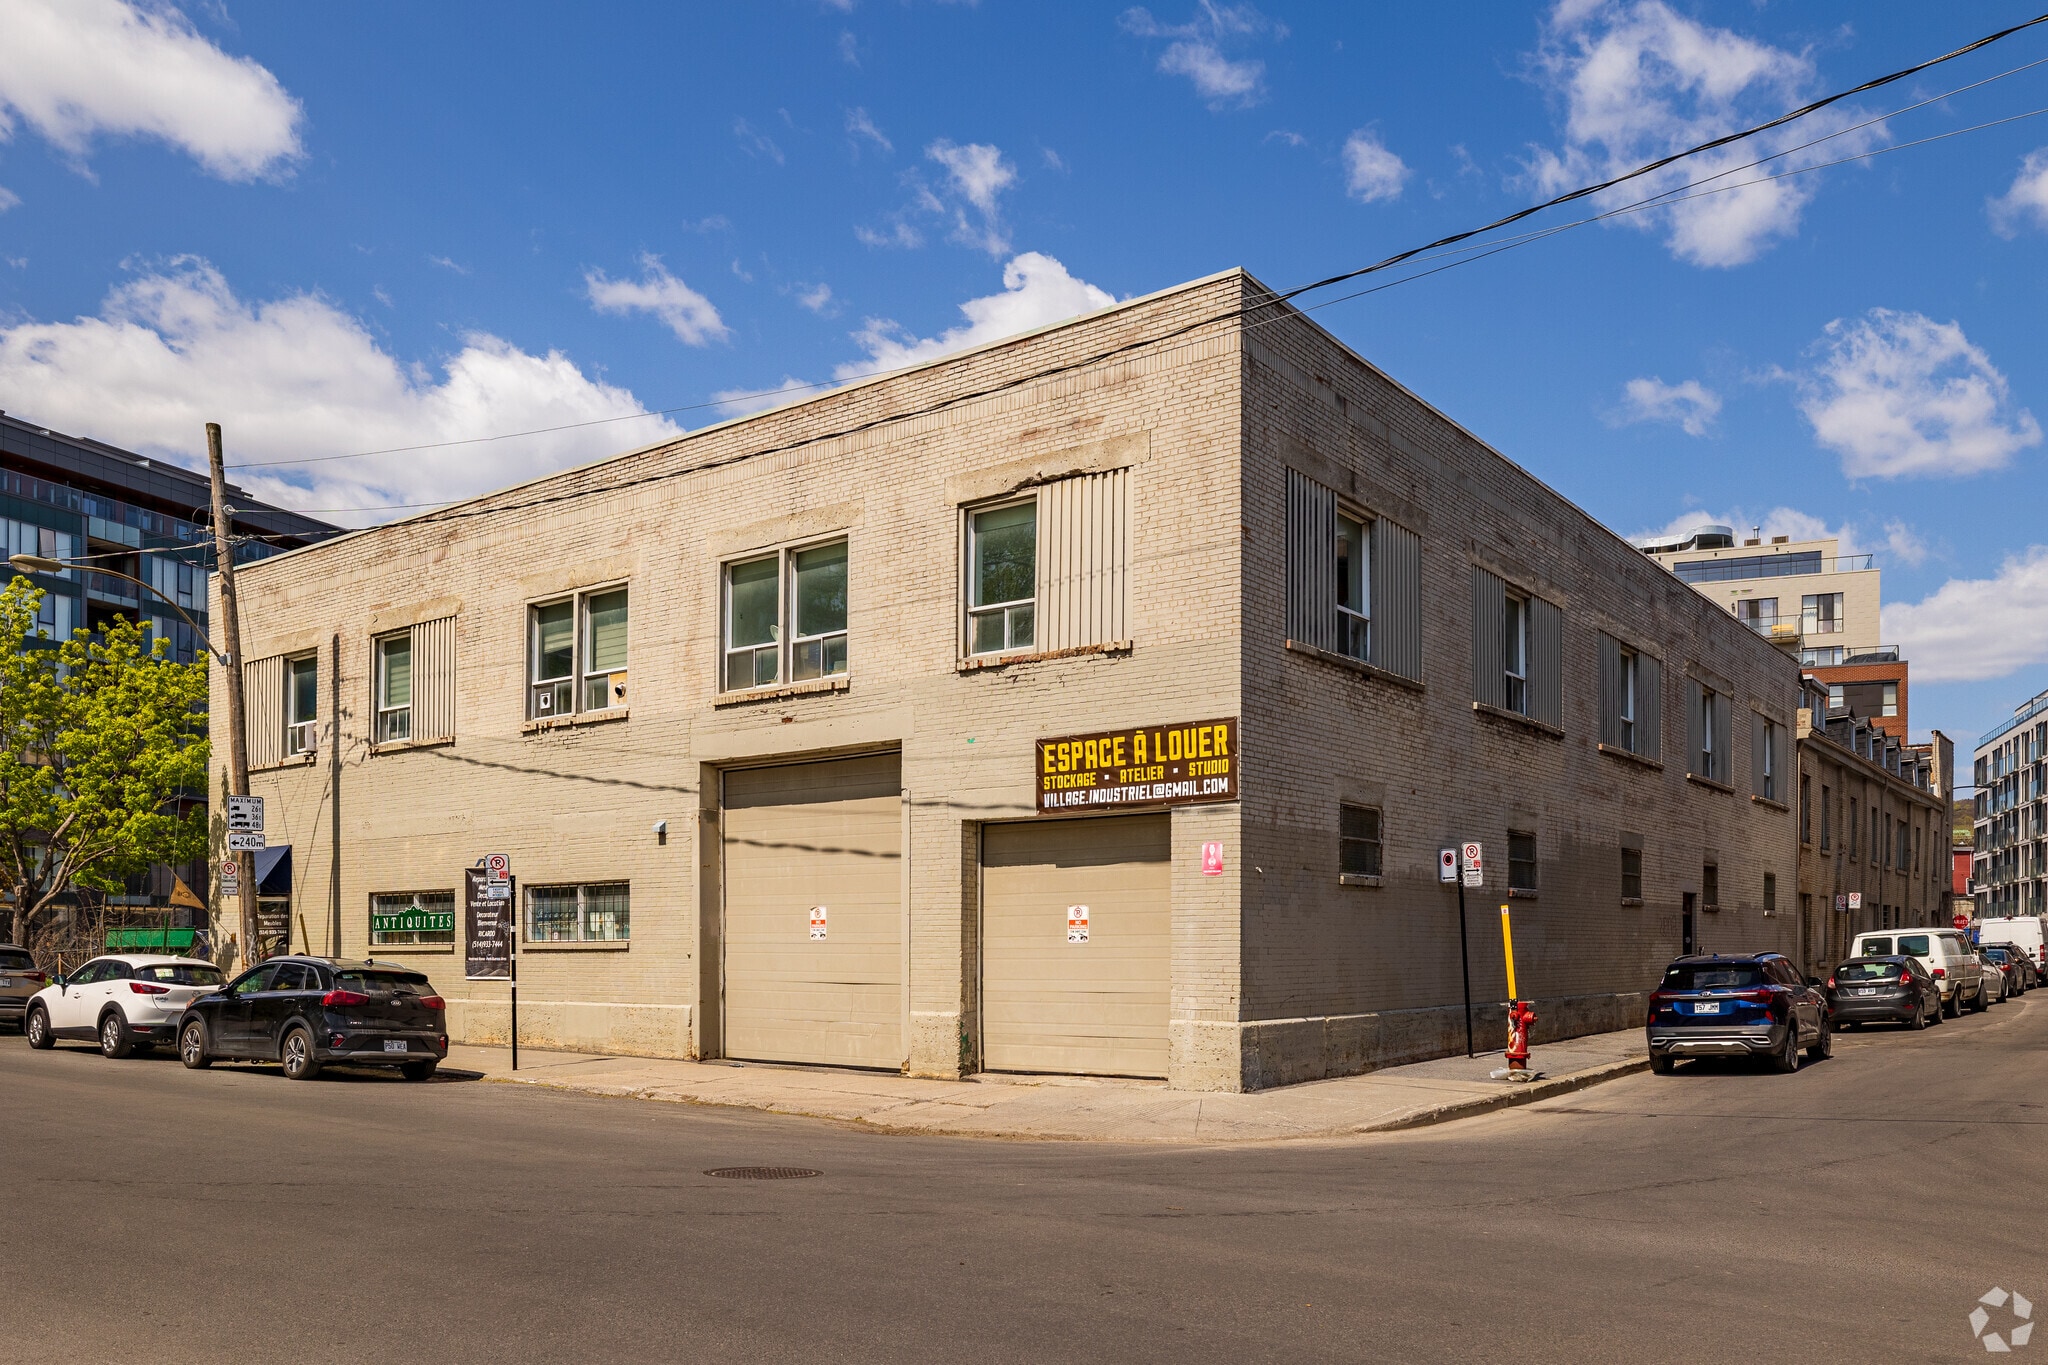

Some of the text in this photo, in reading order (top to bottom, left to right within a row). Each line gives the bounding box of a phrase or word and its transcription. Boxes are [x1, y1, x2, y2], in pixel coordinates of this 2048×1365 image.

[1043, 736, 1127, 774] ESPACE
[1154, 725, 1229, 762] LOUER
[1043, 758, 1230, 790] STOCKAGE ATELIER STUDIO
[1043, 777, 1229, 808] VILLAGE.INDUSTRIEL@GMAIL.COM
[374, 915, 451, 929] ANTIQUITES
